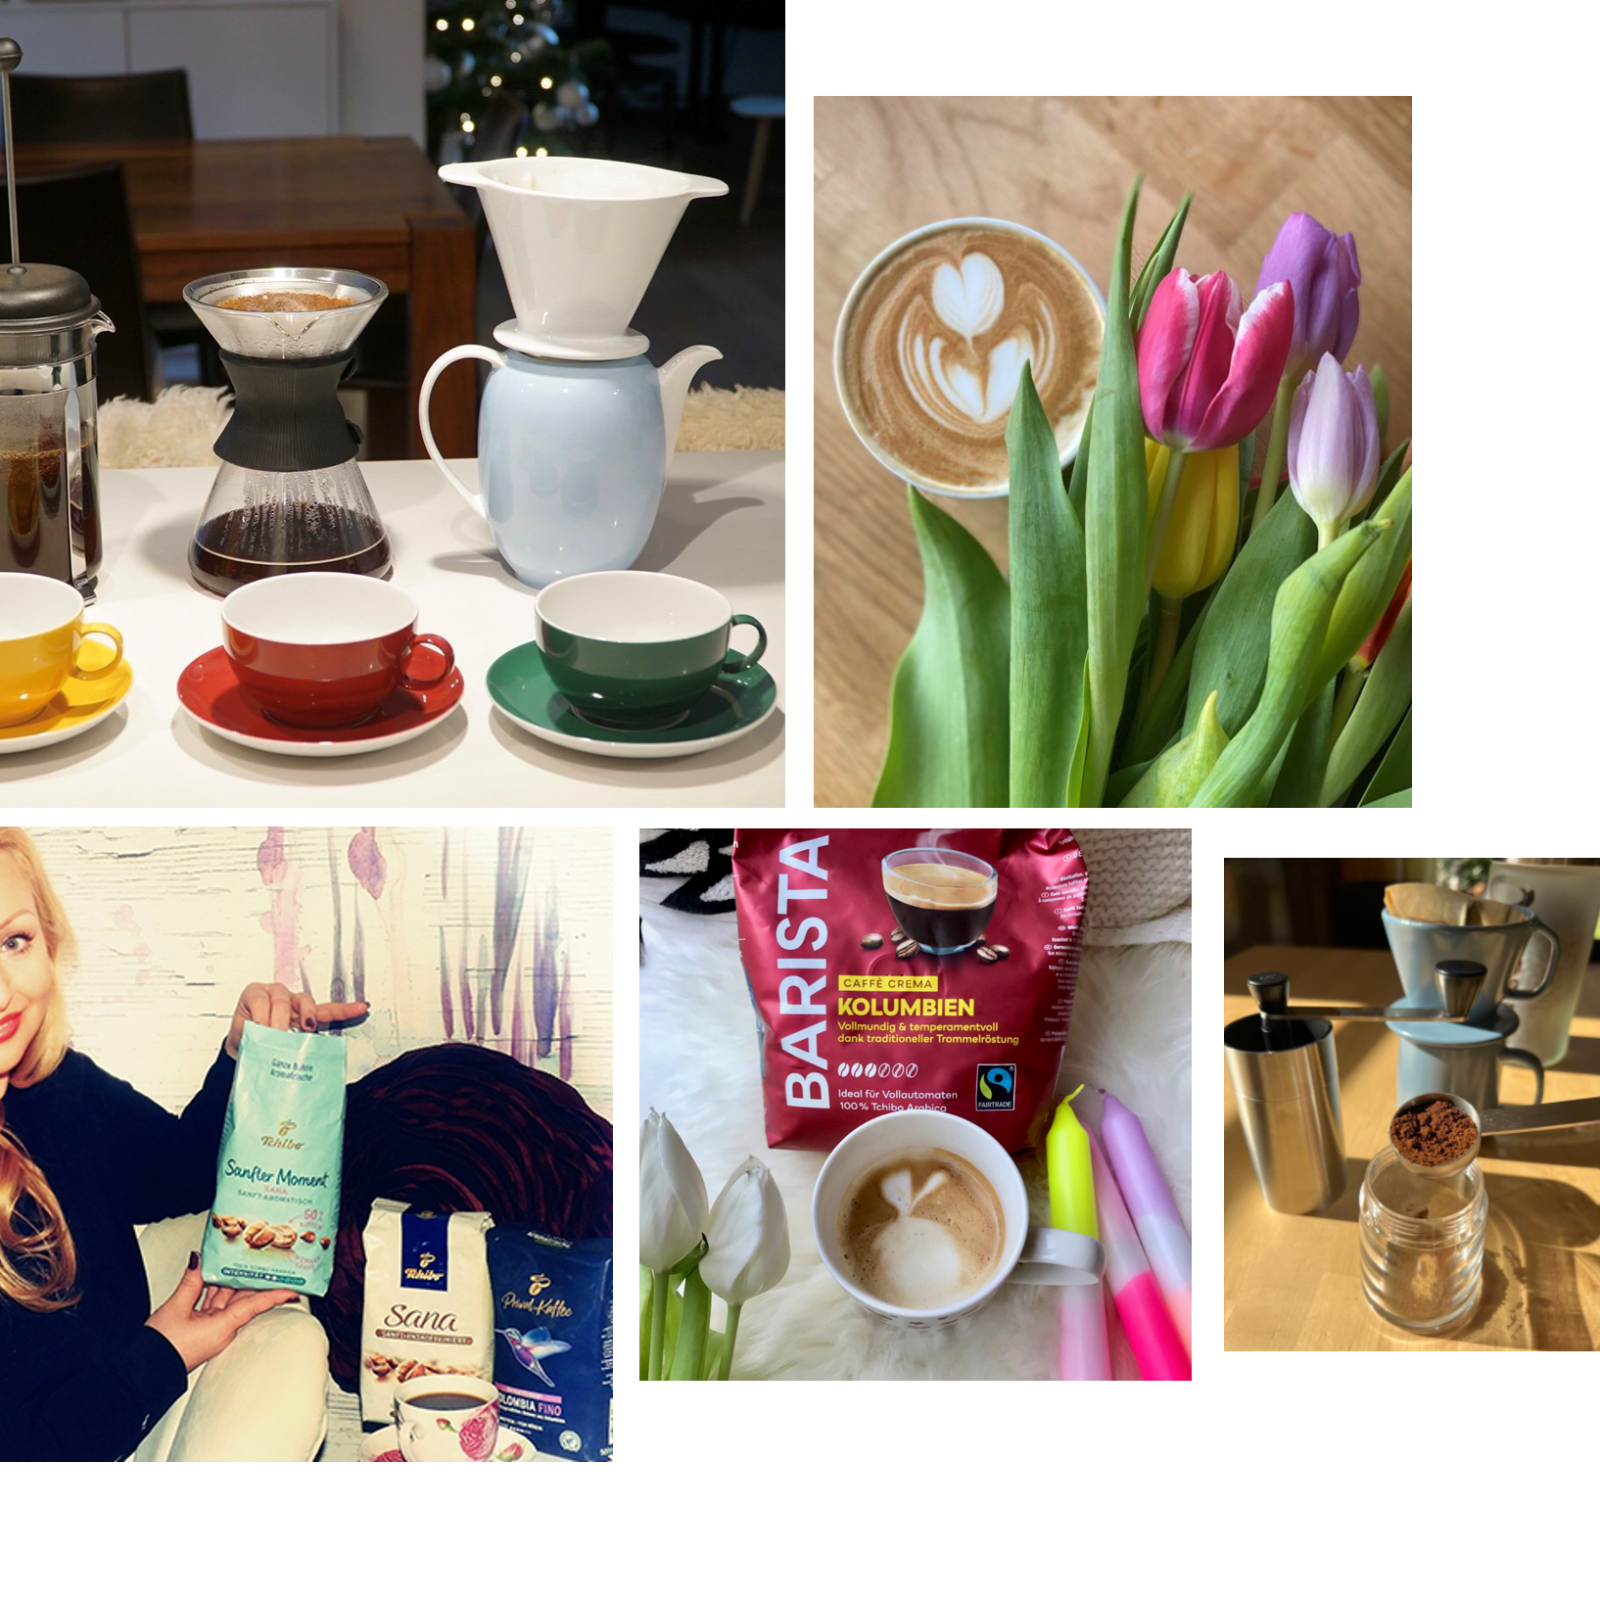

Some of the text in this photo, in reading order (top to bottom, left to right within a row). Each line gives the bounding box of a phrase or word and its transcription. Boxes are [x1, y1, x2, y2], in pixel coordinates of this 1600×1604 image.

[776, 834, 830, 1109] BARISTA
[843, 977, 933, 989] CAFFÈ CREMA
[837, 998, 975, 1017] KOLUMBIEN
[837, 1021, 999, 1034] Vollmundig & temperamentvoll
[837, 1033, 1020, 1046] dank traditioneller Trommelröstung
[838, 1089, 958, 1099] Ideal für Vollautomaten
[839, 1102, 947, 1112] 100 % Tchibo Arabica
[261, 1135, 305, 1150] Tchibo
[225, 1158, 329, 1189] Sanfter Moment
[404, 1267, 444, 1282] Tchibo
[383, 1303, 459, 1333] Sana
[498, 1391, 536, 1412] OLOMBIA
[537, 1402, 562, 1417] FINO
